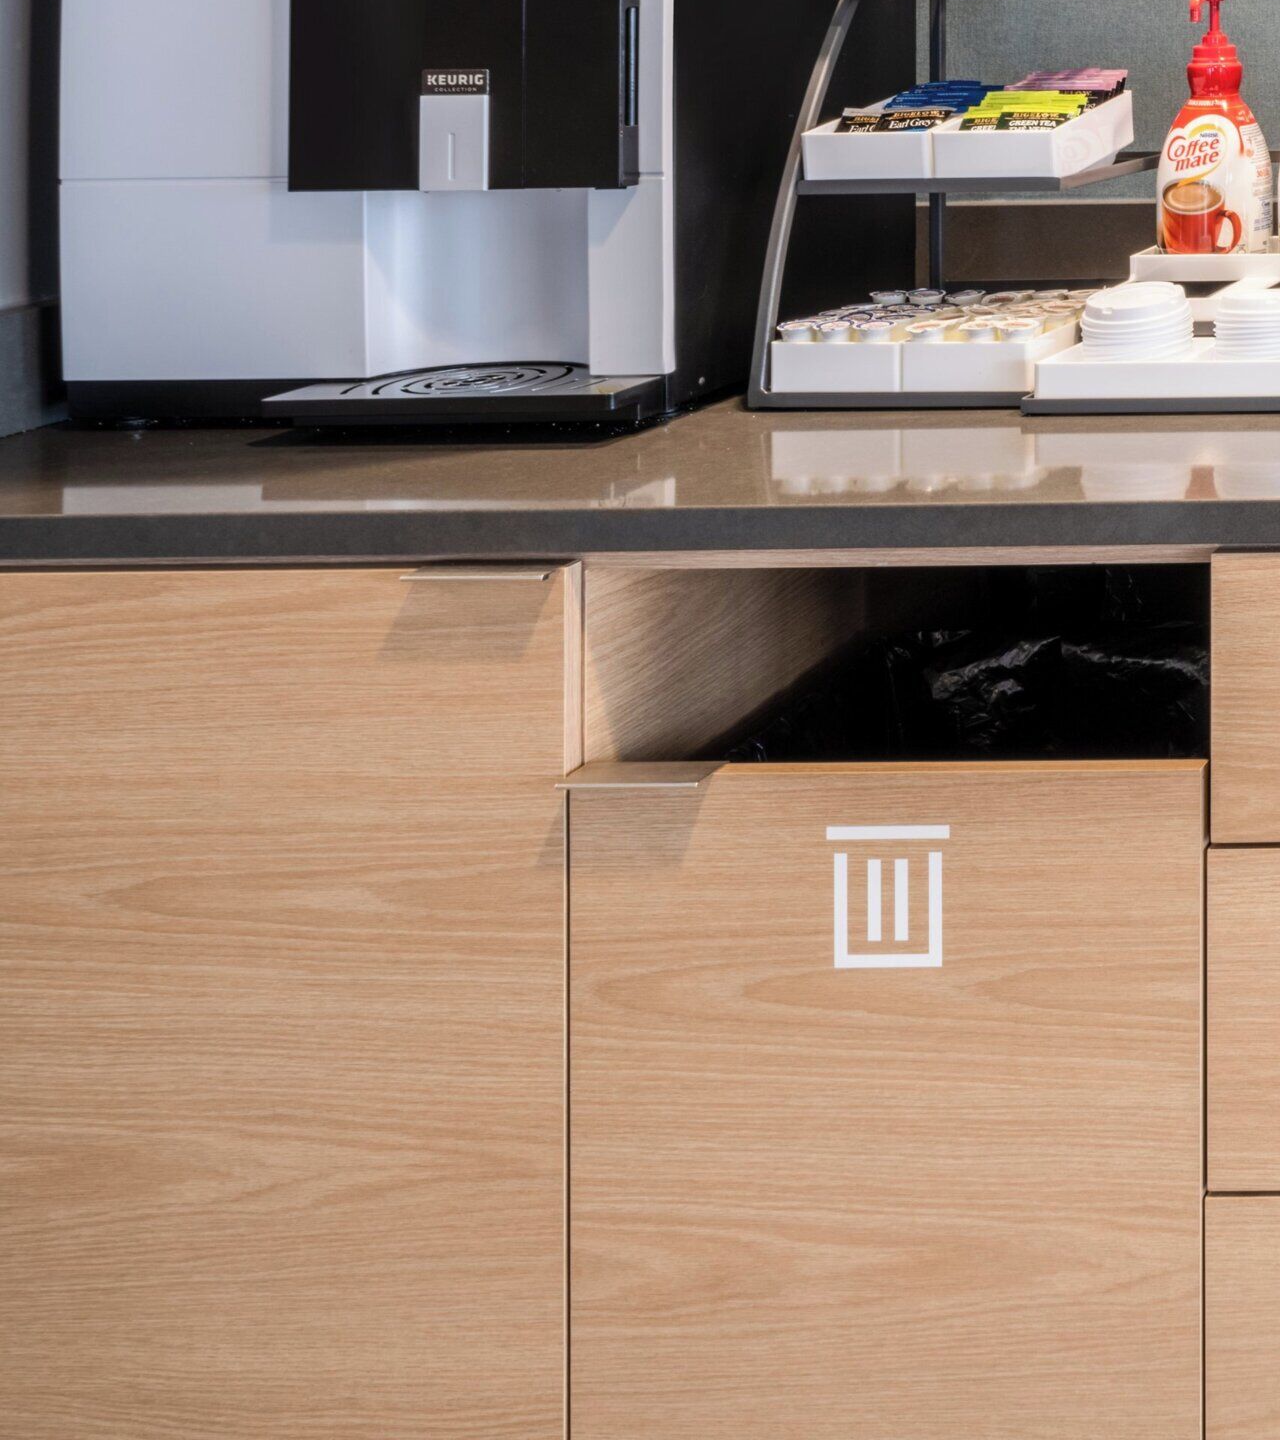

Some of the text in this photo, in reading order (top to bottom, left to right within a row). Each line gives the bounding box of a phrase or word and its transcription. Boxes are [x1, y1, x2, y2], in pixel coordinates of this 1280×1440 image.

[427, 74, 484, 86] KEURIG
[888, 118, 935, 129] Earl Grey
[1167, 135, 1220, 162] Coffee
[1175, 151, 1220, 172] mate
